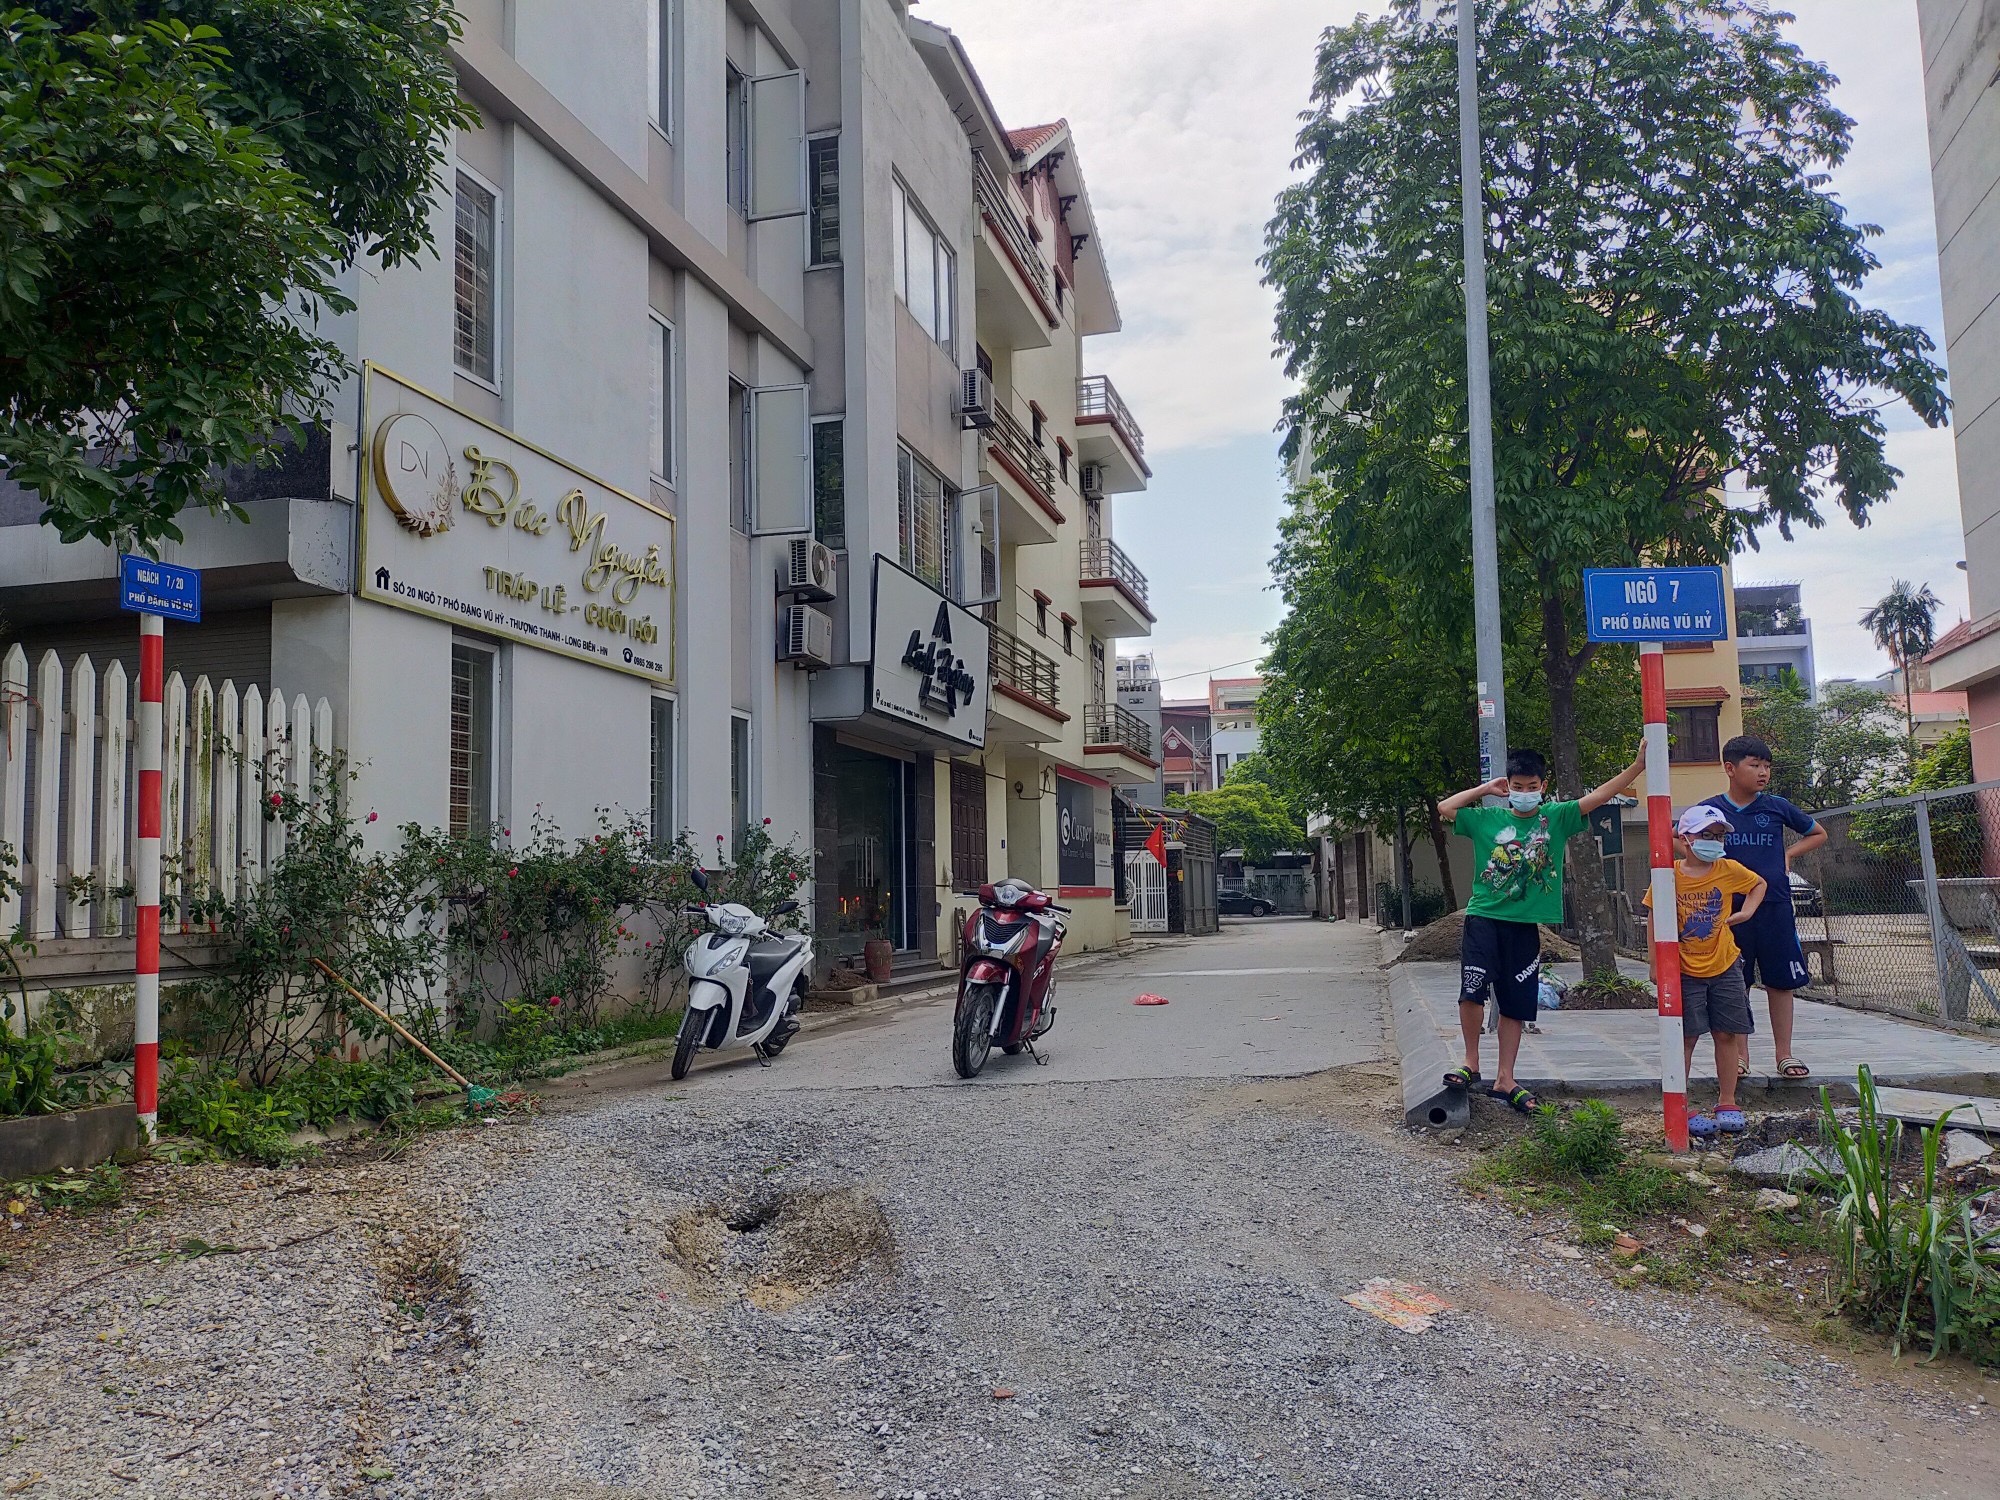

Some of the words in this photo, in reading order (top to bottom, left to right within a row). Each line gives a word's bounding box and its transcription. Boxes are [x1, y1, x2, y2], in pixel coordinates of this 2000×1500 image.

[461, 444, 552, 537] Đức
[556, 488, 672, 604] Nguyễn
[137, 568, 160, 585] NGÁCH
[128, 591, 146, 604] PHỐ
[147, 594, 169, 608] ĐẶNG
[171, 598, 182, 610] VŨ
[1624, 576, 1658, 604] NGÕ
[1669, 580, 1680, 603] 7
[407, 586, 416, 599] 20
[418, 590, 436, 605] NGÕ
[437, 596, 442, 606] 7
[461, 602, 482, 617] ĐẶNG
[510, 617, 538, 635] THƯỢNG
[539, 627, 561, 643] THANH
[565, 635, 582, 649] LONG
[583, 641, 596, 653] BIÊN
[600, 645, 609, 657] HN
[1601, 612, 1629, 630] PHỐ
[1673, 612, 1691, 629] VŨ
[1695, 609, 1712, 629] HỶ
[1071, 816, 1092, 847] Casper
[1724, 832, 1774, 847] RBALIFE
[1463, 972, 1485, 989] 23
